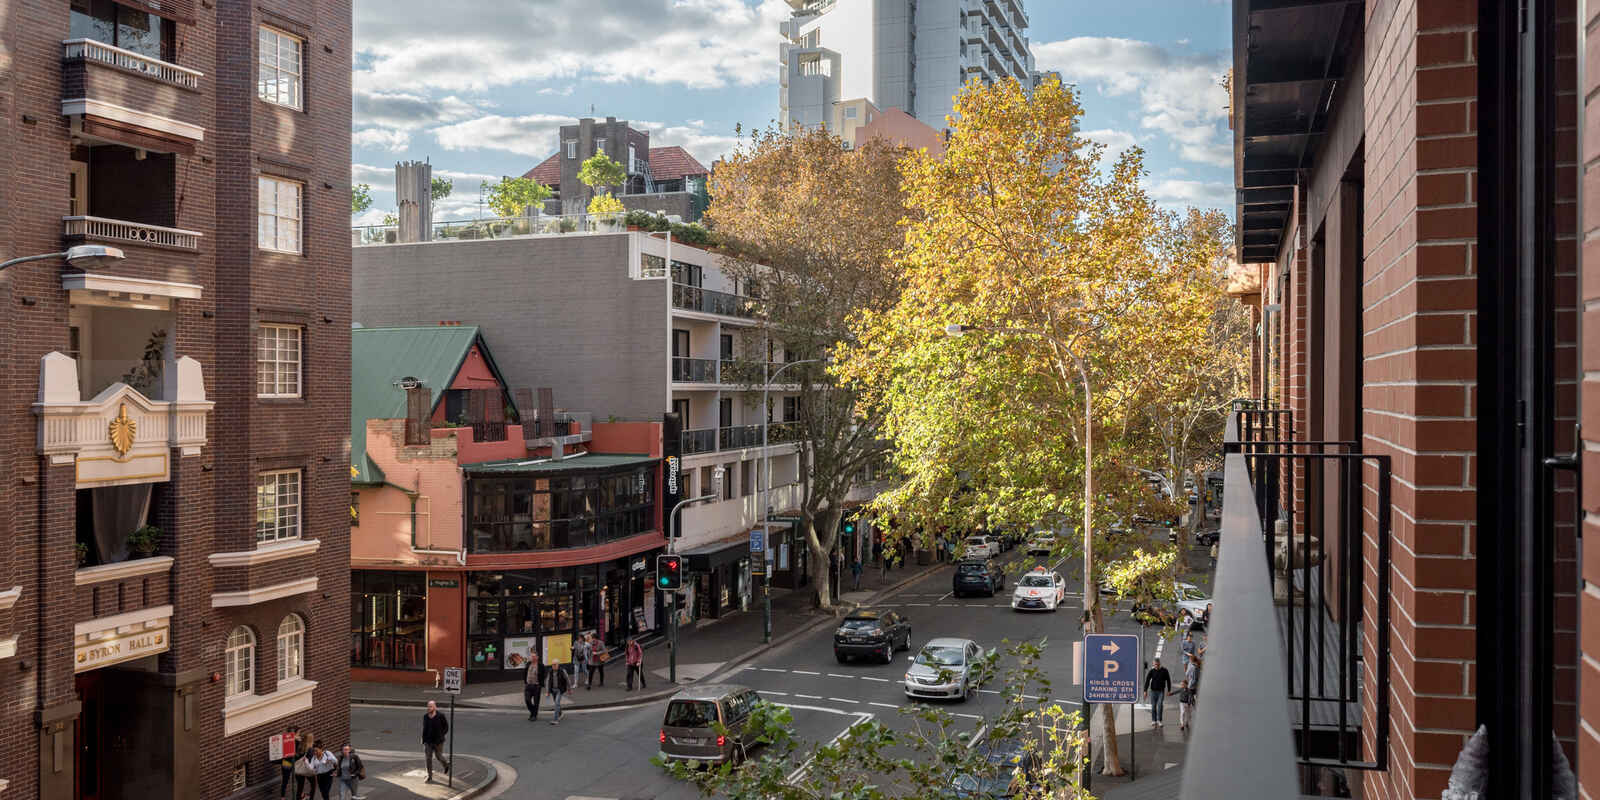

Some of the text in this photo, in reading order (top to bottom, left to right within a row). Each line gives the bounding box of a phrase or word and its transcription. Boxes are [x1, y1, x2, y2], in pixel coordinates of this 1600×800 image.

[89, 636, 153, 660] BYRON HALL
[447, 670, 459, 679] ONE
[1104, 660, 1119, 678] P
[446, 679, 460, 687] WAY
